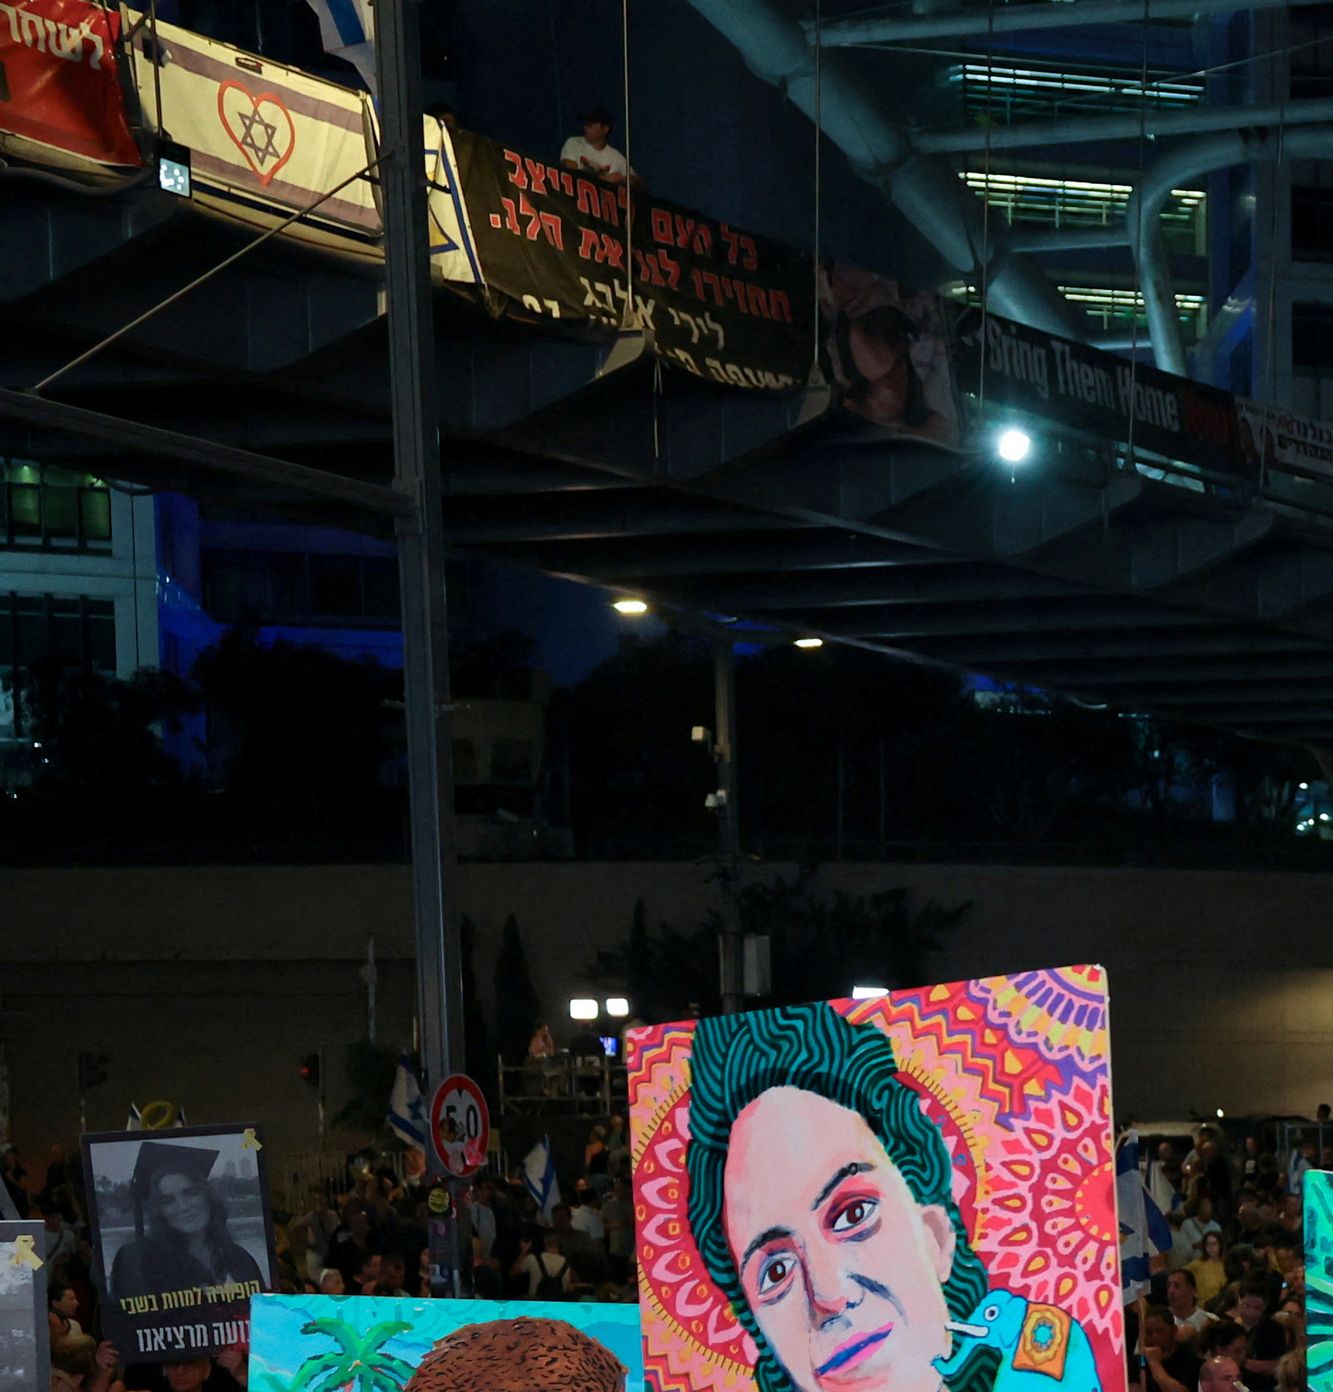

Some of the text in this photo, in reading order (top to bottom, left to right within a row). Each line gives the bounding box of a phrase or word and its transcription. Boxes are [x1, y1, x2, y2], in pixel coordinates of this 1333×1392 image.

[578, 227, 625, 270] את
[651, 208, 712, 255] העם
[720, 223, 758, 271] כל
[986, 319, 1049, 399] Bring
[1050, 339, 1116, 409] Them
[1116, 367, 1180, 432] Home
[119, 1294, 158, 1315] בשבי
[163, 1286, 202, 1310] למוות
[136, 1323, 209, 1353] מרציאנו
